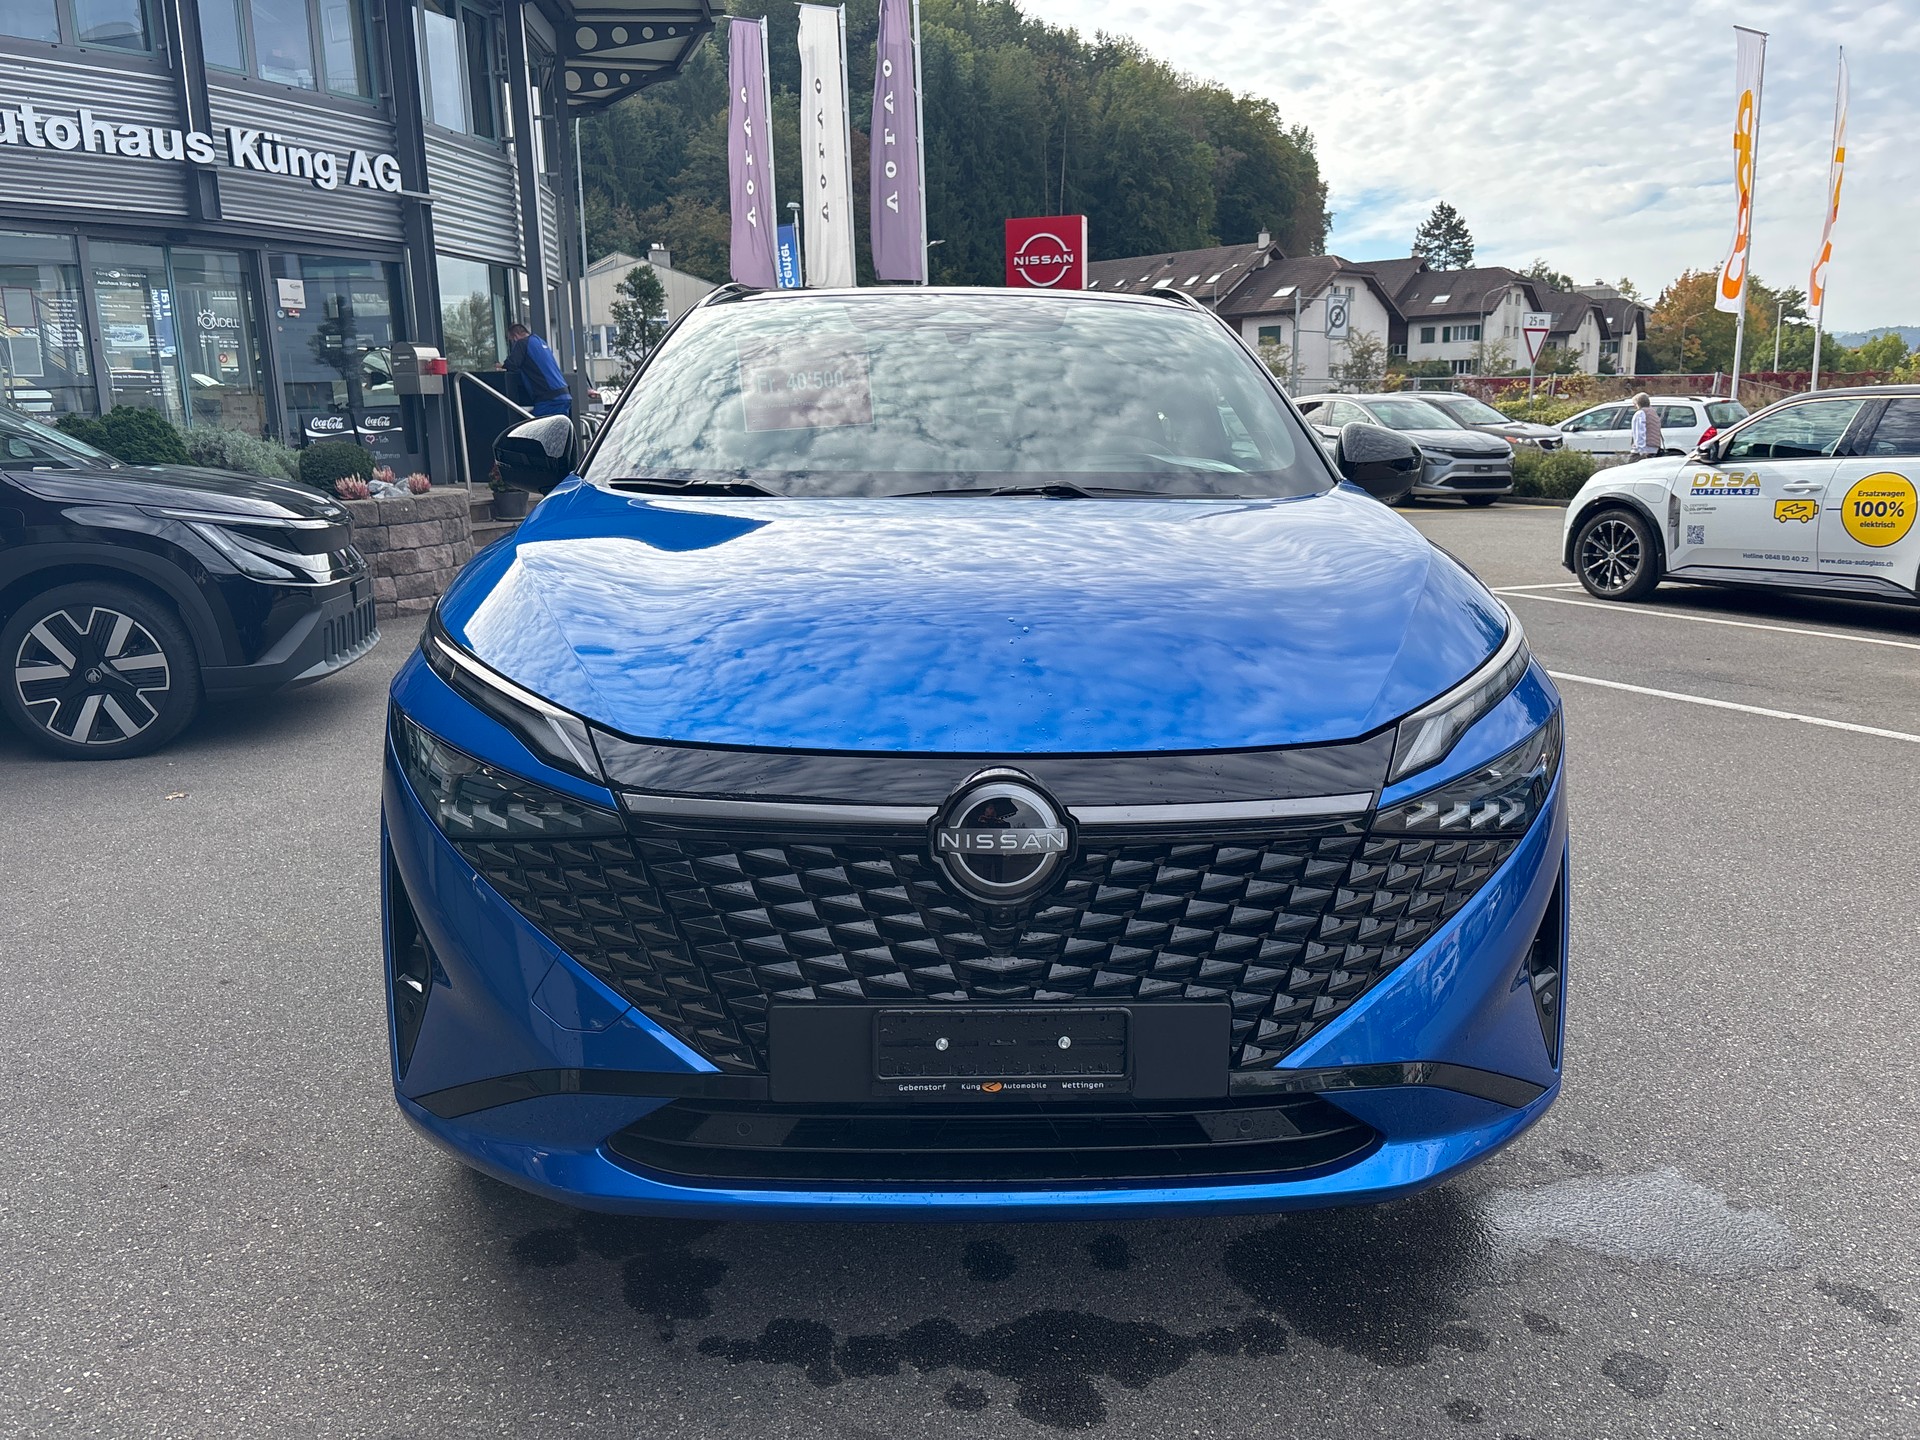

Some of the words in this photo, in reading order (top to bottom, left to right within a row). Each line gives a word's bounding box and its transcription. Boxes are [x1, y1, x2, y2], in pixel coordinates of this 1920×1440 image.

[229, 126, 339, 191] Küng
[348, 150, 403, 194] AG
[1013, 254, 1074, 266] NISSAN
[1529, 316, 1538, 327] 25
[1539, 318, 1546, 327] m
[311, 416, 344, 430] Coca-Cola
[364, 415, 391, 427] Coca-Cola
[1692, 471, 1762, 488] DESA
[1690, 488, 1760, 496] AUTOGLASS
[1857, 490, 1906, 498] Ersatzwagen
[1853, 500, 1905, 518] 100%
[1859, 520, 1896, 529] elektrisch
[1742, 552, 1764, 560] Hotline
[1764, 553, 1781, 561] 0848
[1782, 554, 1790, 562] 80
[1819, 558, 1894, 568] www.desa-autoglass.ch
[940, 831, 1065, 850] NISSAN
[898, 1083, 947, 1092] Gebenstorf
[961, 1083, 981, 1091] Küng
[1002, 1082, 1048, 1090] Automobile
[1062, 1081, 1105, 1090] Wettingen
